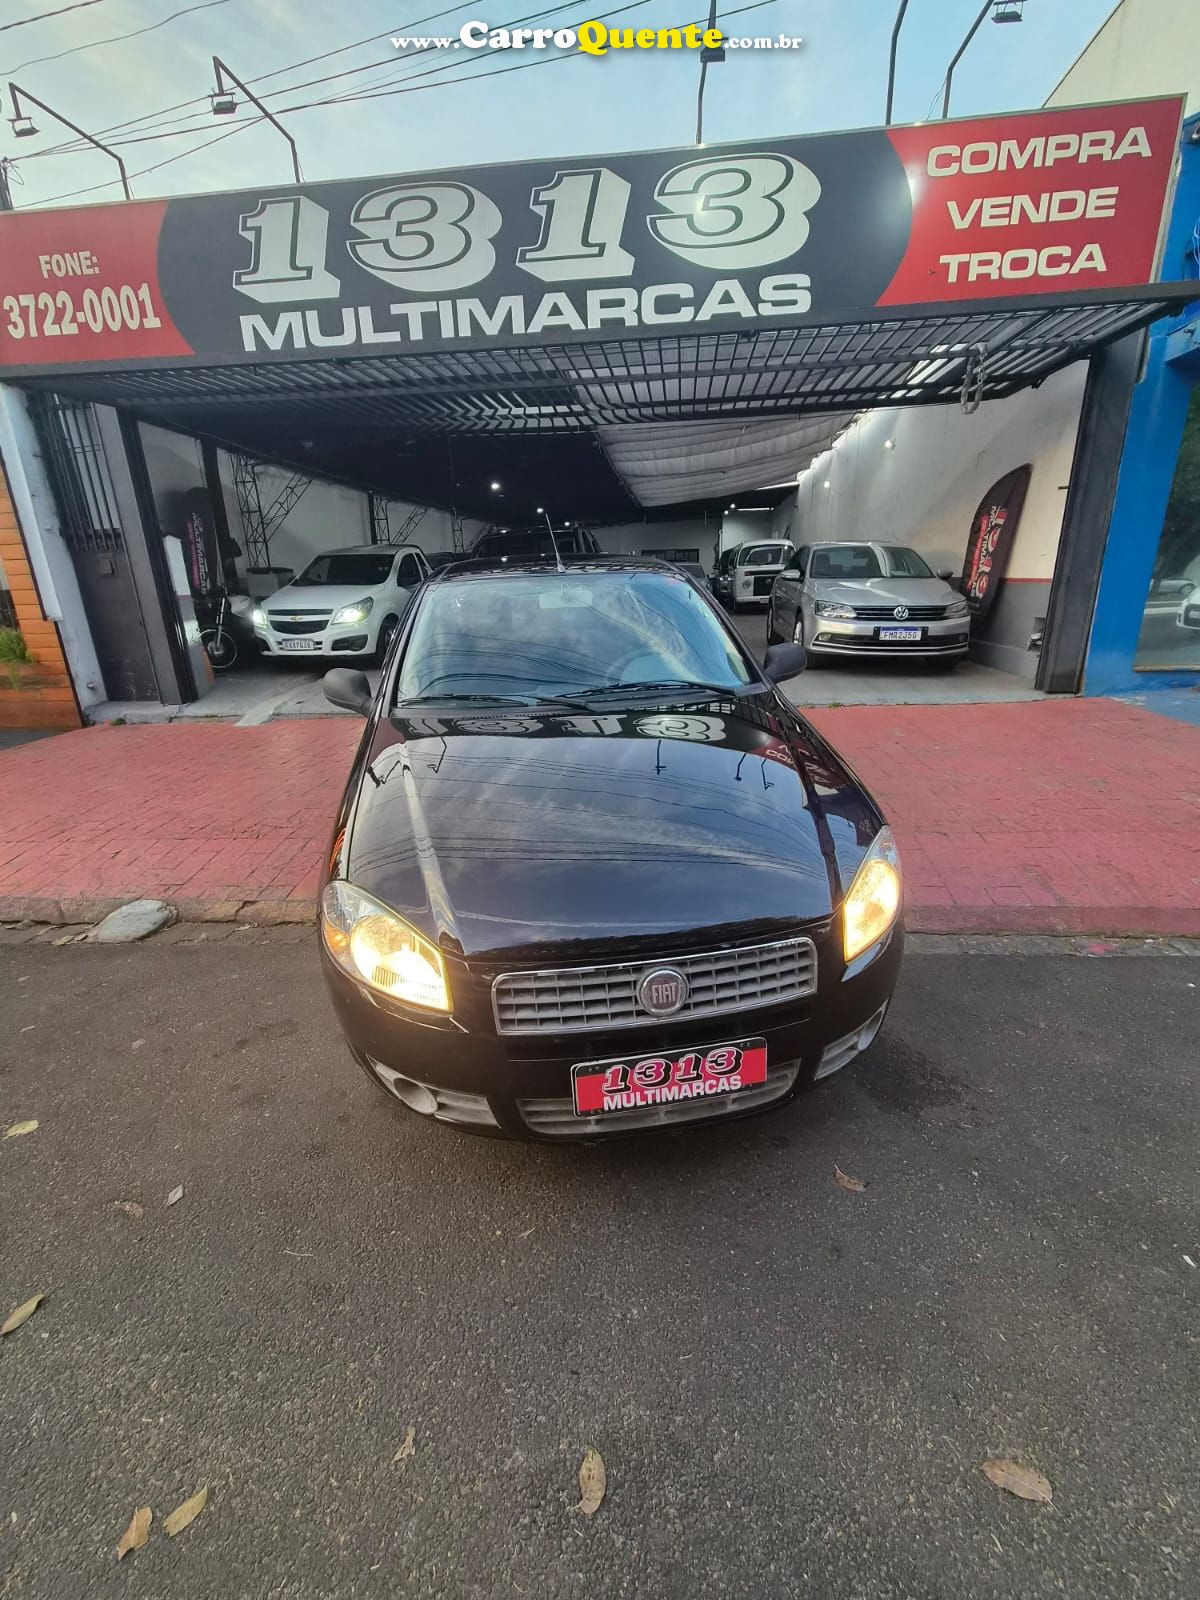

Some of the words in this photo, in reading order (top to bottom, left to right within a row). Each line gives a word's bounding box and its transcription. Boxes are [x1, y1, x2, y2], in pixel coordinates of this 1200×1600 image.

[926, 126, 1152, 178] COMPRA
[233, 152, 822, 303] 1313
[946, 186, 1119, 230] VENDE
[39, 251, 101, 279] FONE:
[939, 243, 1107, 283] TROCA
[3, 282, 161, 339] 3722-0001
[239, 274, 812, 352] MULTIMARCAS
[651, 982, 678, 1004] FIAT
[602, 1047, 743, 1096] 1313
[603, 1075, 742, 1111] MULTIMARCAS
